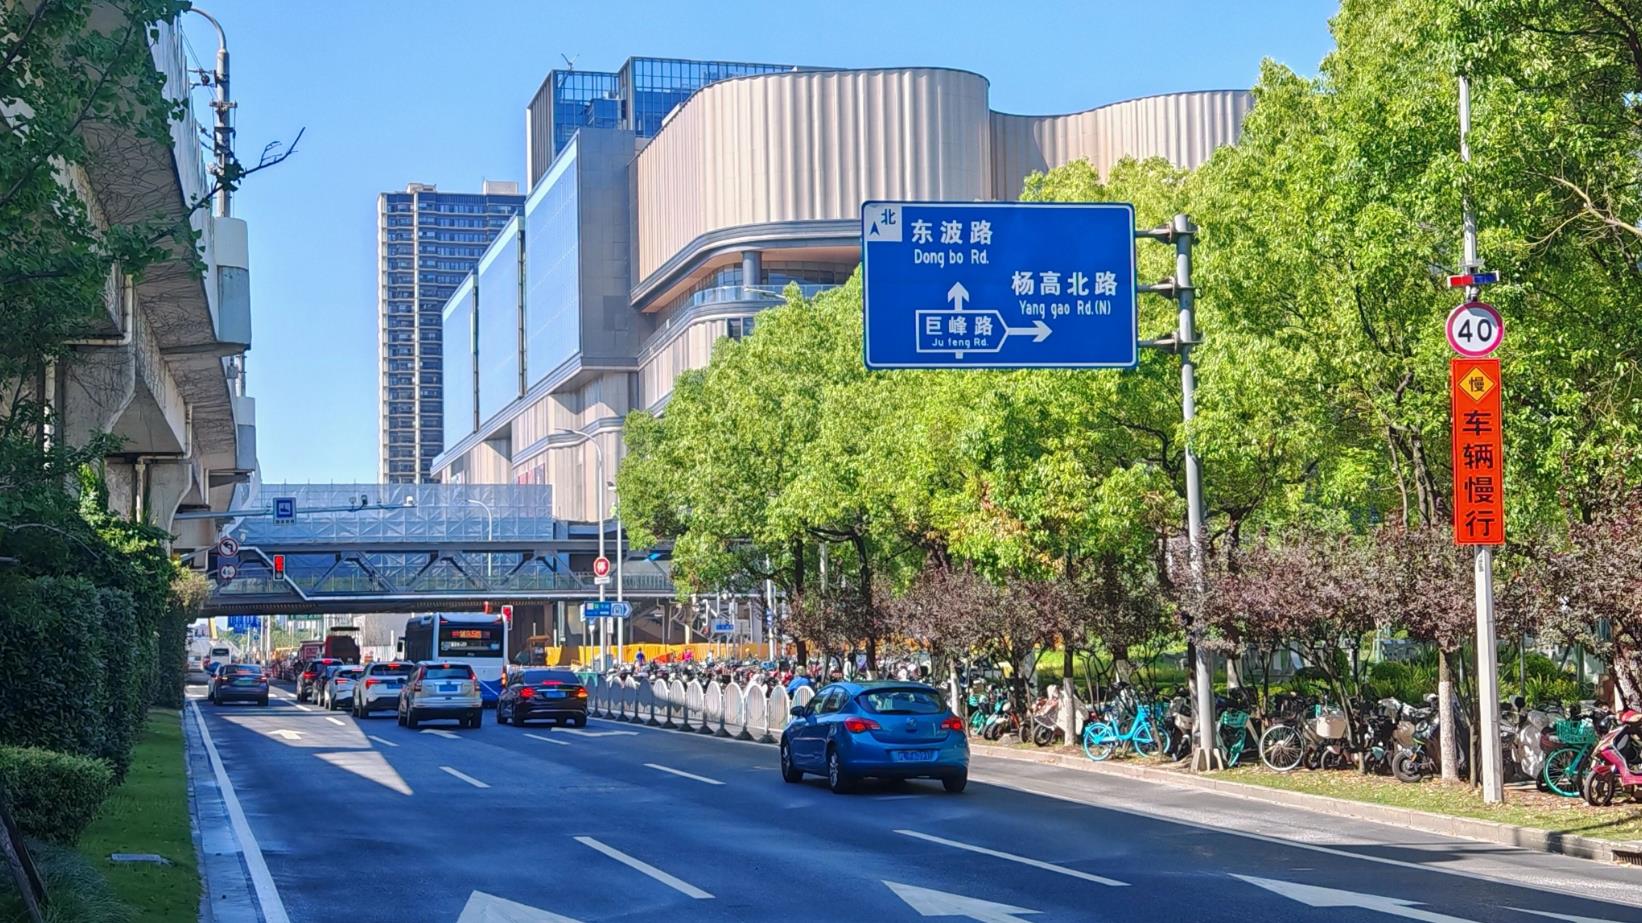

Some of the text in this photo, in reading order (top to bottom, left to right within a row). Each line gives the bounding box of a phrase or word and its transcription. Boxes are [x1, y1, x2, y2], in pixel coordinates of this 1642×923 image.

[881, 209, 896, 226] 北
[911, 219, 993, 245] 东波路
[914, 248, 990, 269] Dong bo Rd.
[1011, 270, 1118, 296] 杨高北路
[1018, 299, 1046, 320] Yang
[1050, 303, 1071, 320] gao
[925, 315, 994, 336] 巨峰路
[1458, 318, 1493, 343] 40
[931, 337, 990, 349] Ju feng Rd.
[1468, 376, 1485, 393] 慢
[1462, 409, 1496, 538] 车辆慢行
